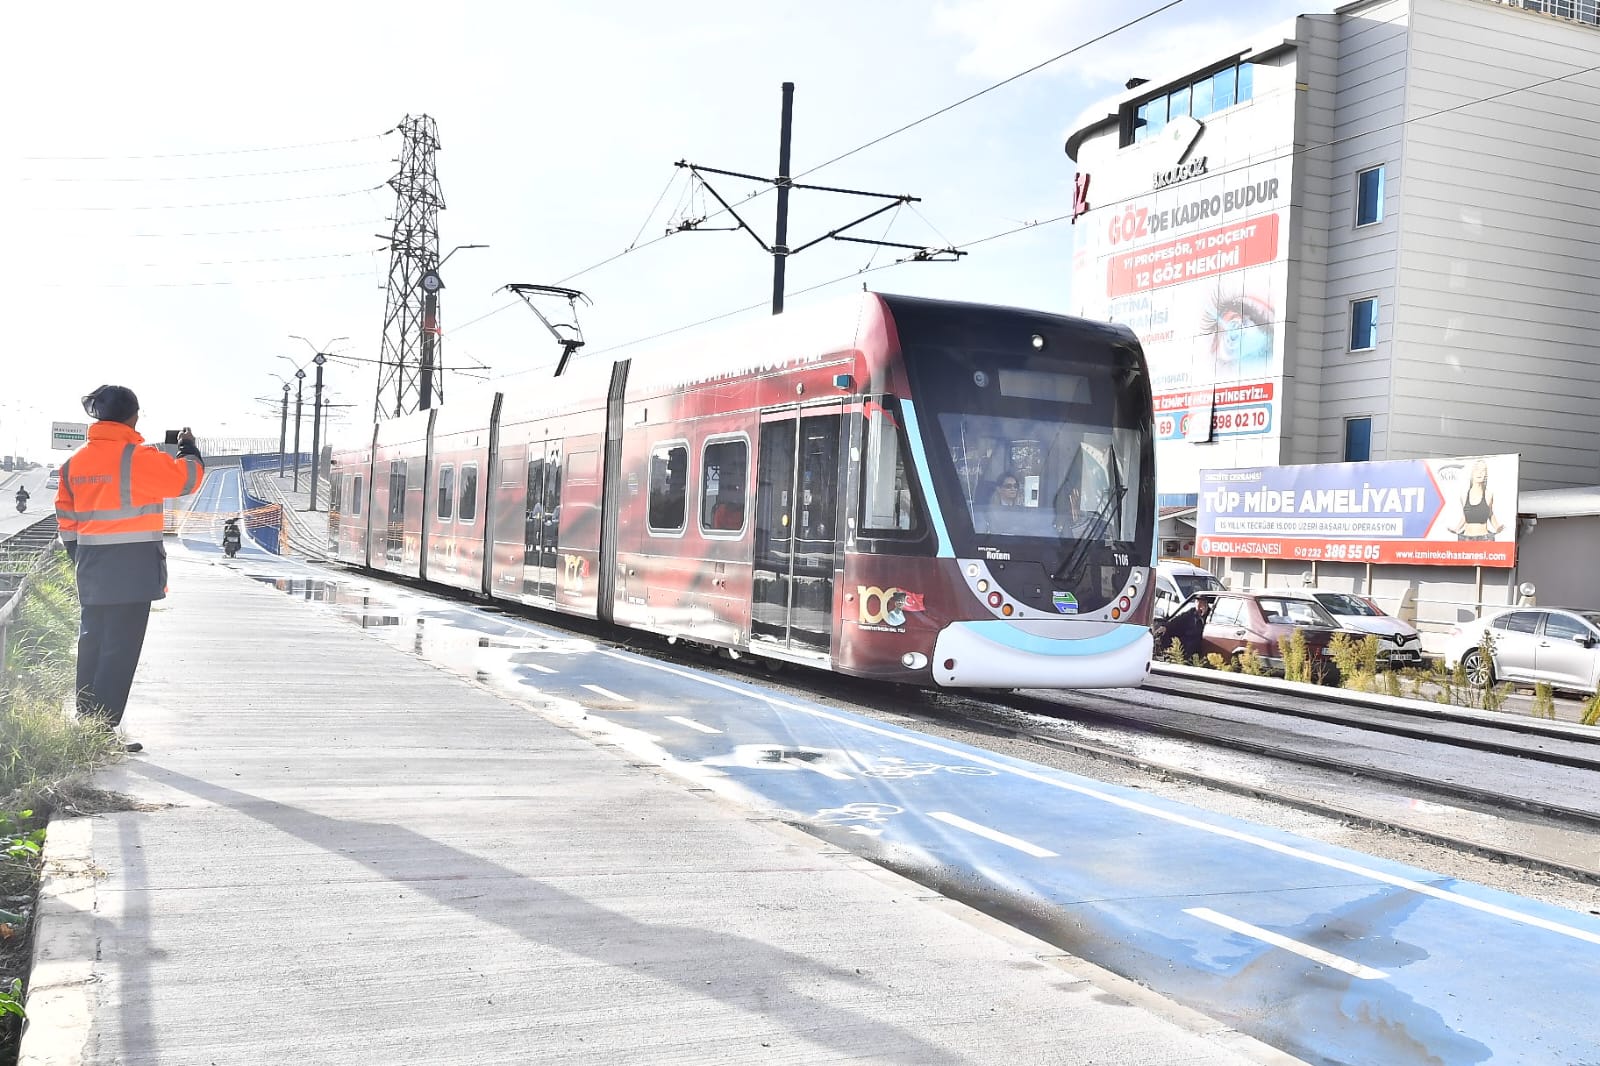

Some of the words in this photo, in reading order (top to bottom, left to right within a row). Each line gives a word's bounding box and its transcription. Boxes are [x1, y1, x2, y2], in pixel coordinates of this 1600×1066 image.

[1171, 195, 1220, 227] KADRO
[1224, 178, 1279, 214] BUDUR
[1207, 225, 1257, 248] DOÇENT
[1136, 272, 1150, 288] 12
[1152, 263, 1182, 284] GÖZ
[1186, 246, 1239, 275] HEKİMİ
[1159, 420, 1172, 434] 69
[1235, 413, 1249, 428] 02
[1252, 411, 1265, 426] 10
[1204, 486, 1240, 513] TÜP
[1244, 485, 1294, 513] MİDE
[1299, 482, 1425, 513] AMELİYATI
[1352, 522, 1397, 532] OPERASYON
[987, 551, 1011, 561] Rotem
[1113, 553, 1129, 566] T106
[1308, 548, 1322, 557] 232
[1348, 544, 1363, 559] 55
[1364, 544, 1380, 560] 05
